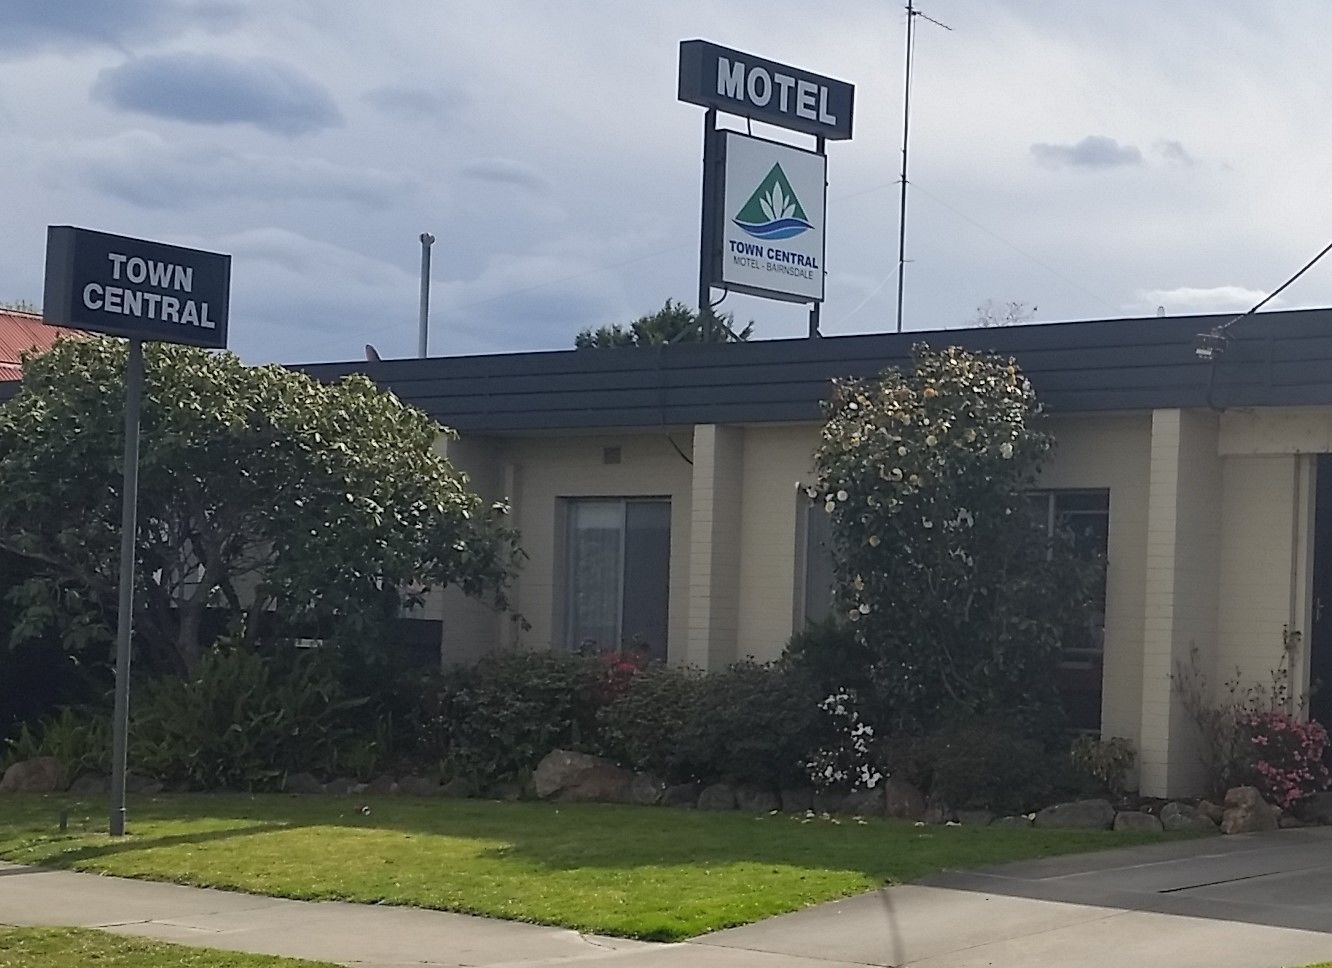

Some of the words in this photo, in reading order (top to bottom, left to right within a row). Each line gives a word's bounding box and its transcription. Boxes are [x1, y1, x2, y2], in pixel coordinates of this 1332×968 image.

[717, 56, 836, 126] MOTEL
[108, 252, 193, 292] TOWN
[729, 240, 763, 258] TOWN
[767, 248, 819, 270] CENTRAL
[733, 255, 760, 270] MOTEL
[766, 262, 814, 280] BAIRNSDALE
[83, 282, 216, 330] CENTRAL
